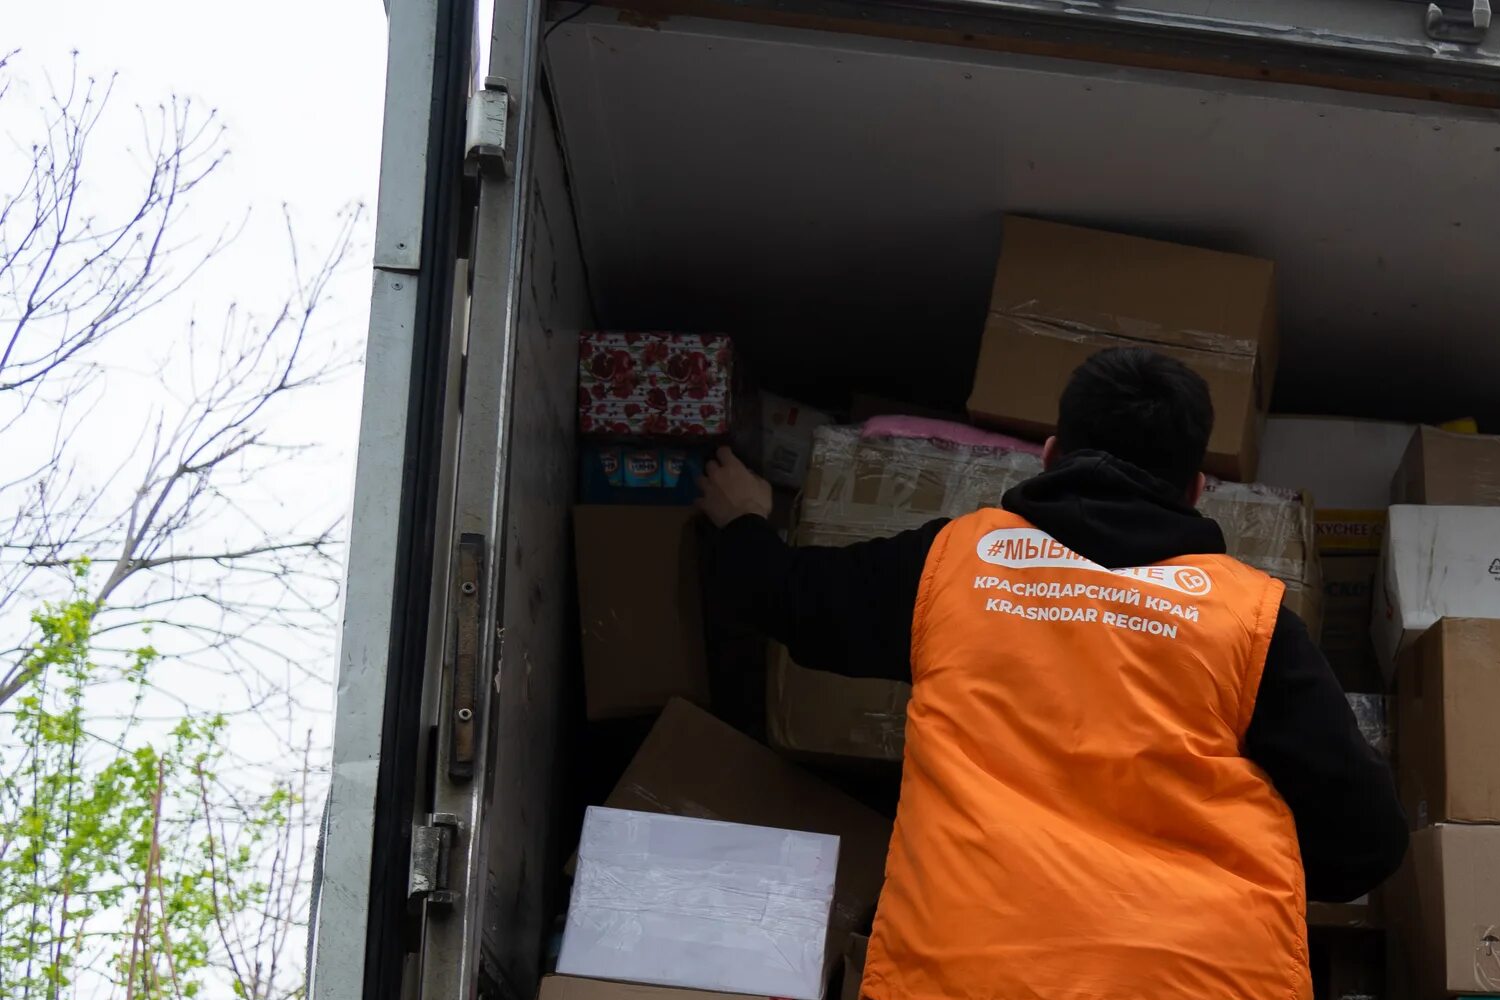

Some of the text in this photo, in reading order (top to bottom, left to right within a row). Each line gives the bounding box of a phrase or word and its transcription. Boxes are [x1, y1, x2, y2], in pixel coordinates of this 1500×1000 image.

[973, 575, 1200, 622] КРАСНОДАРСКИЙ КРАЙ
[985, 598, 1178, 639] KRASNODAR REGION
